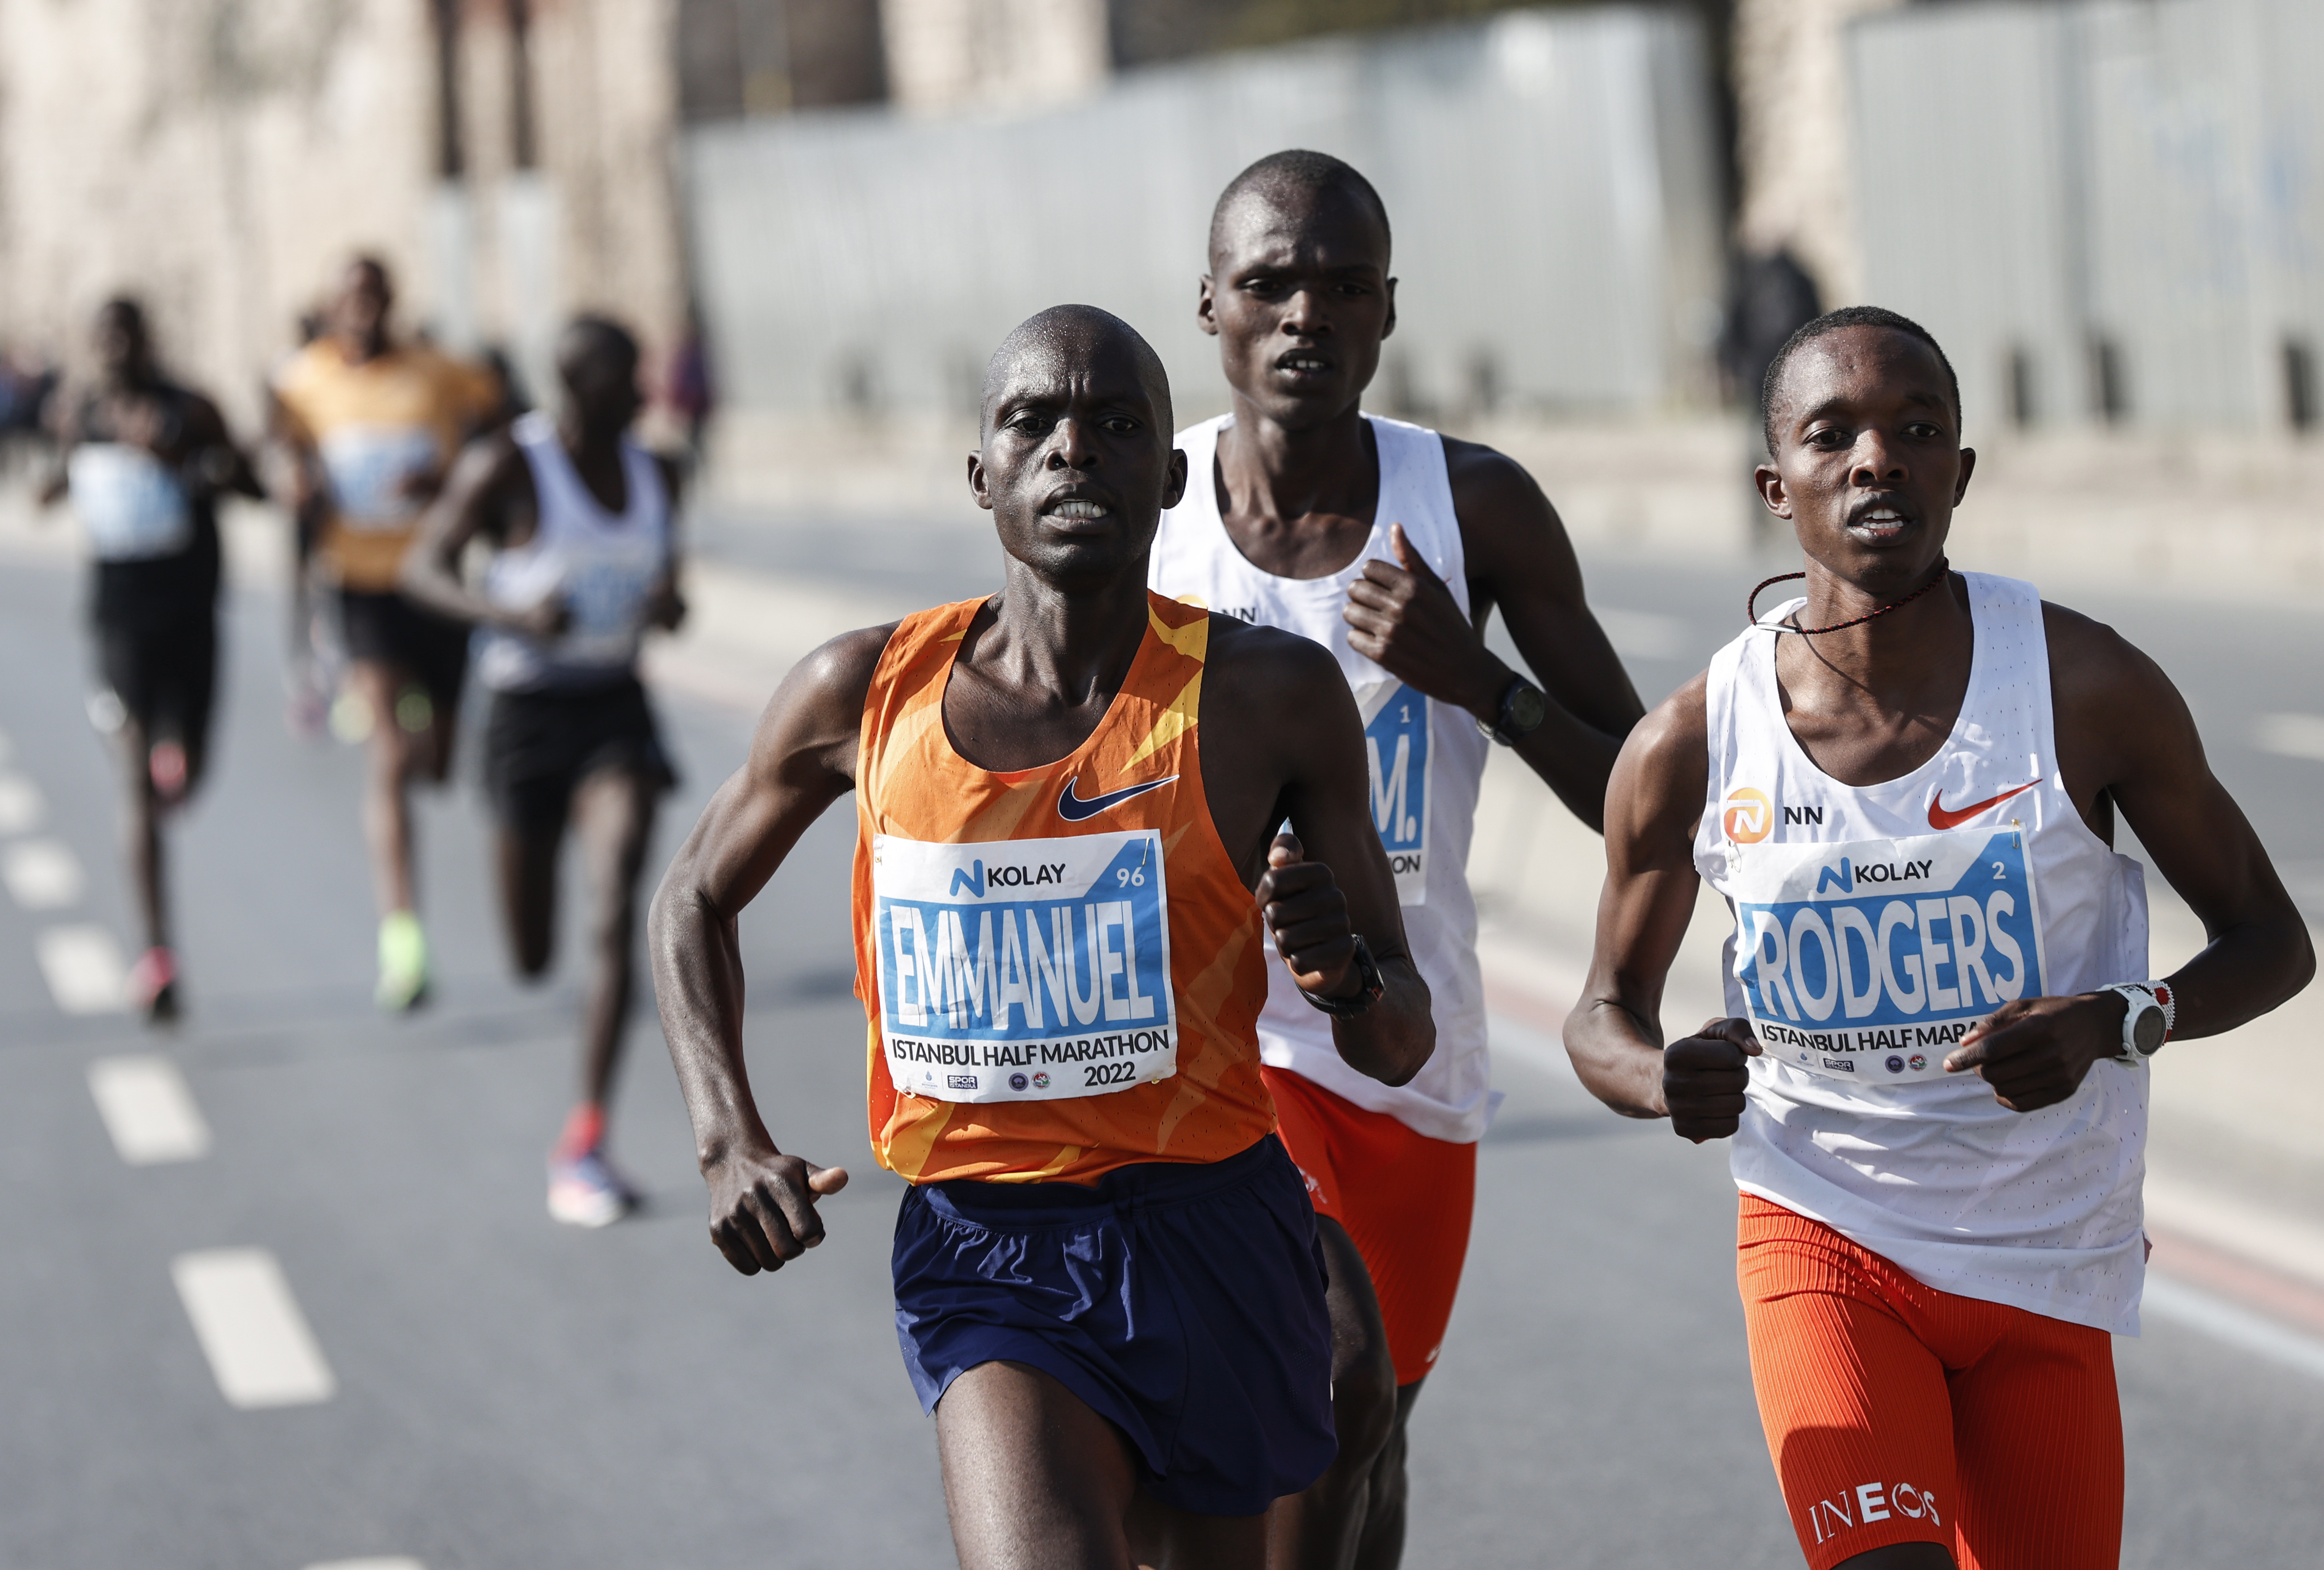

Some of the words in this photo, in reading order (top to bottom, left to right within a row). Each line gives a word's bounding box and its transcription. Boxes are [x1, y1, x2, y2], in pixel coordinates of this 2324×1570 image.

[1400, 705, 1411, 723] 1
[1783, 806, 1823, 825] NN
[987, 863, 1066, 888] KOLAY
[1117, 866, 1145, 888] 96
[1855, 860, 1933, 883] KOLAY
[1992, 861, 2006, 880] 2
[890, 900, 1155, 1030] EMMANUEL
[1752, 890, 2025, 1022] RODGERS
[892, 1039, 981, 1067] ISTANBUL
[984, 1044, 1037, 1066] HALF
[1041, 1029, 1169, 1064] MARATHON
[1761, 1023, 1856, 1053] ISTANBUL
[1857, 1029, 1913, 1051] HALF
[1084, 1061, 1136, 1087] 2022
[1825, 1059, 1851, 1068] SPOR
[1809, 1481, 1940, 1544] INEOS
